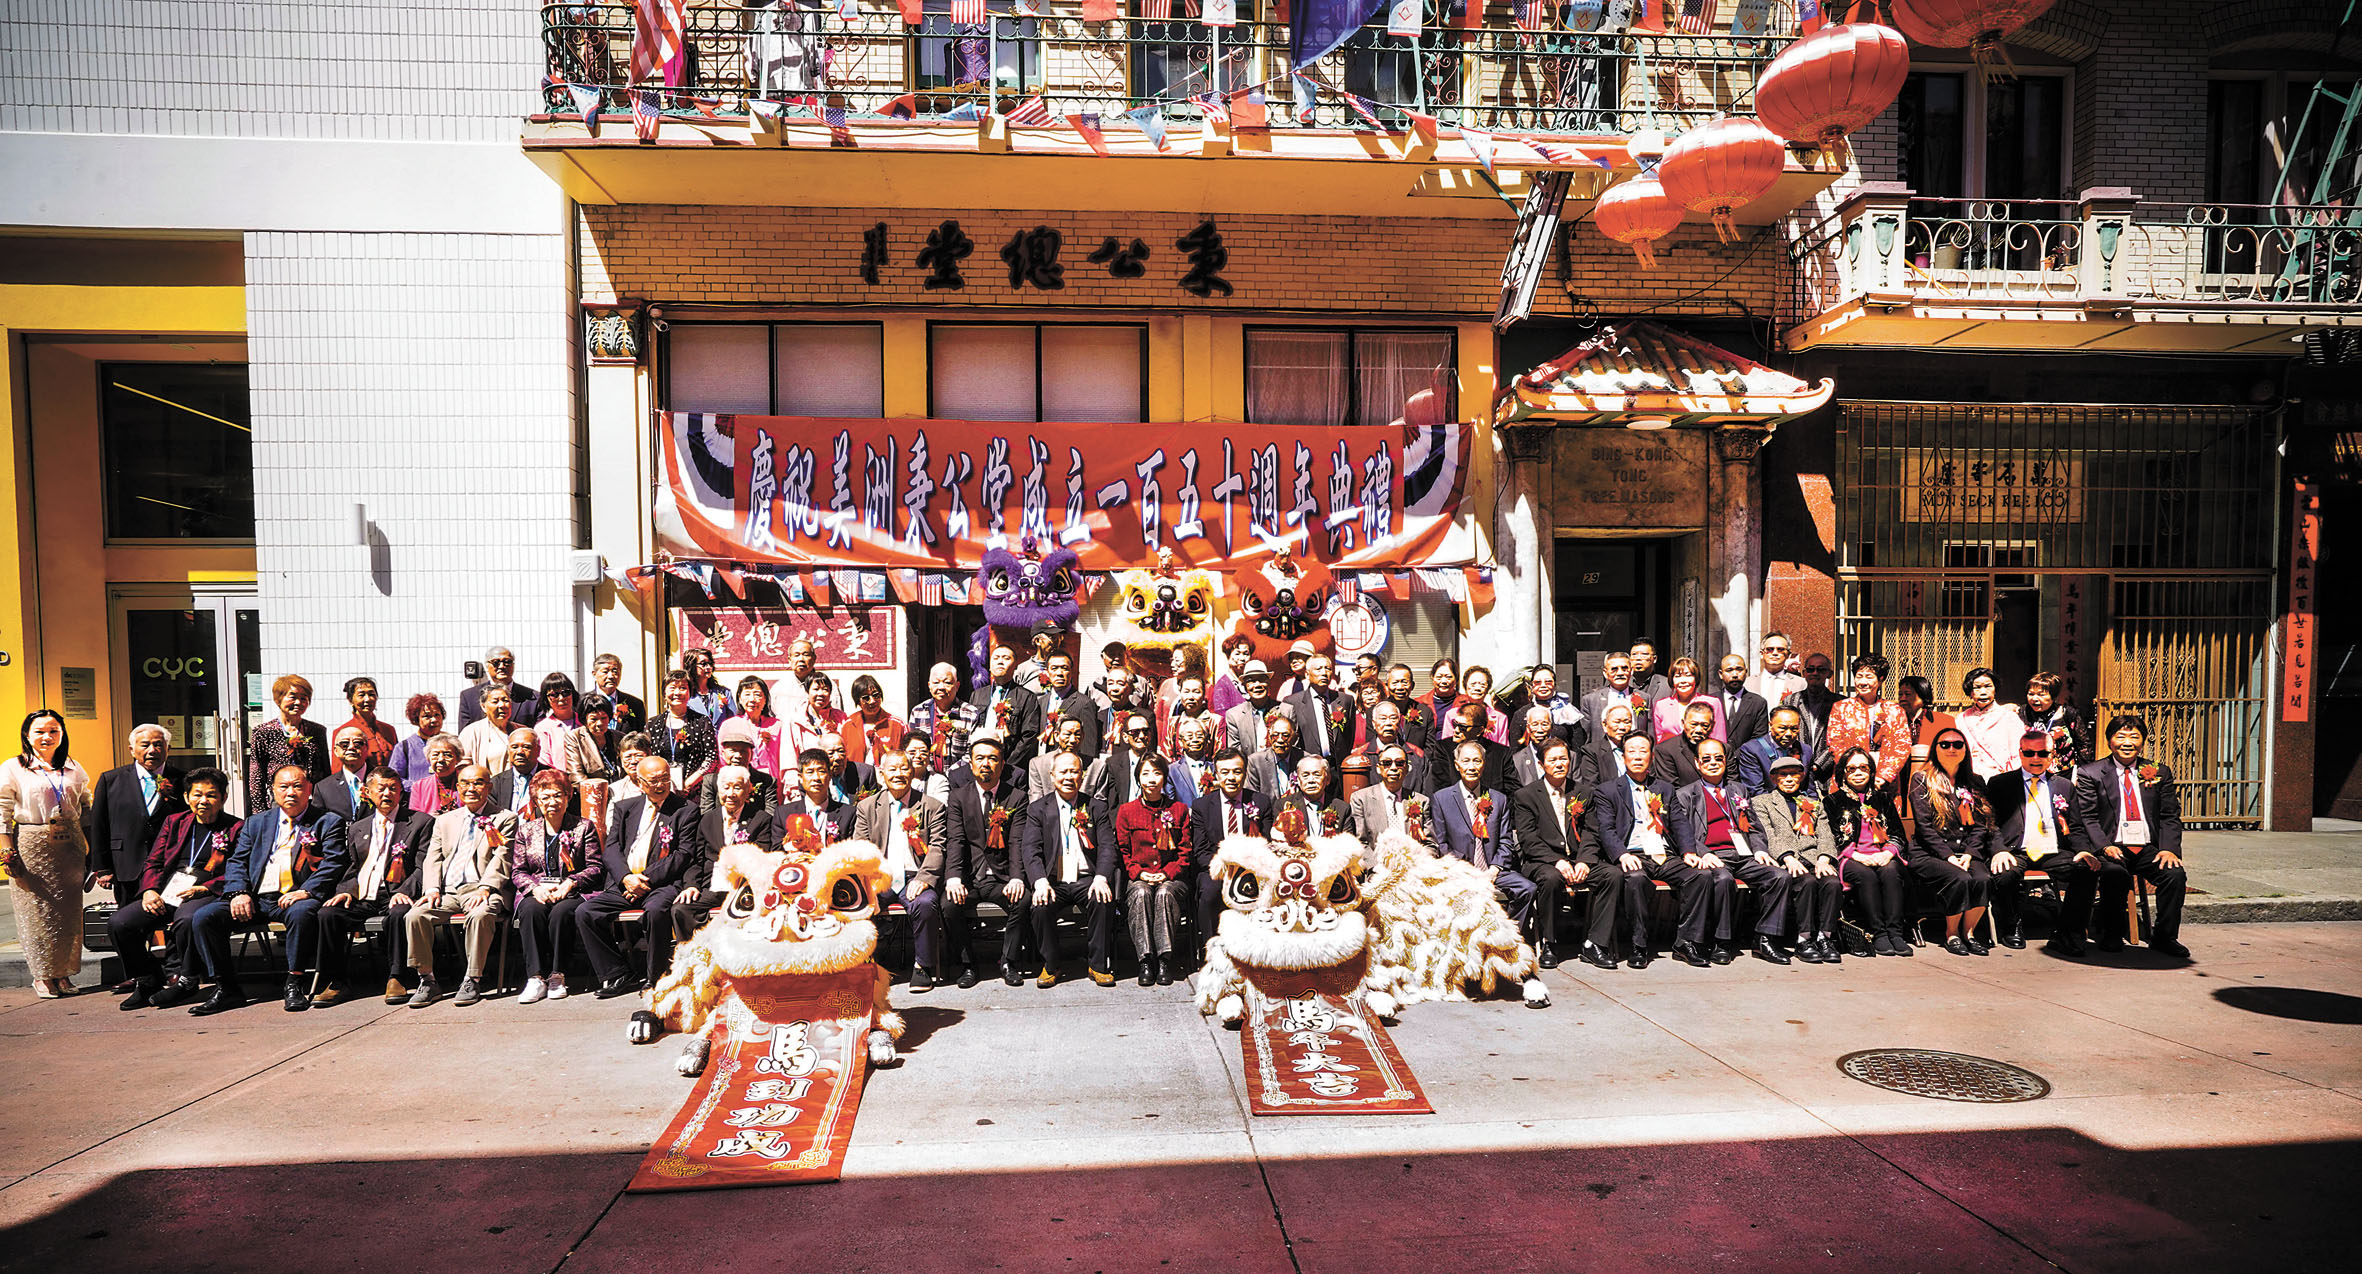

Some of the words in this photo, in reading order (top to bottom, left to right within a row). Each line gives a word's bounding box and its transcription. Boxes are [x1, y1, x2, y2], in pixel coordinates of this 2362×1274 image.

[743, 428, 1393, 557] 慶祝美洲秉公堂成立一百五十週年典禮
[1583, 573, 1599, 584] 29
[706, 1019, 821, 1160] 馬到功成
